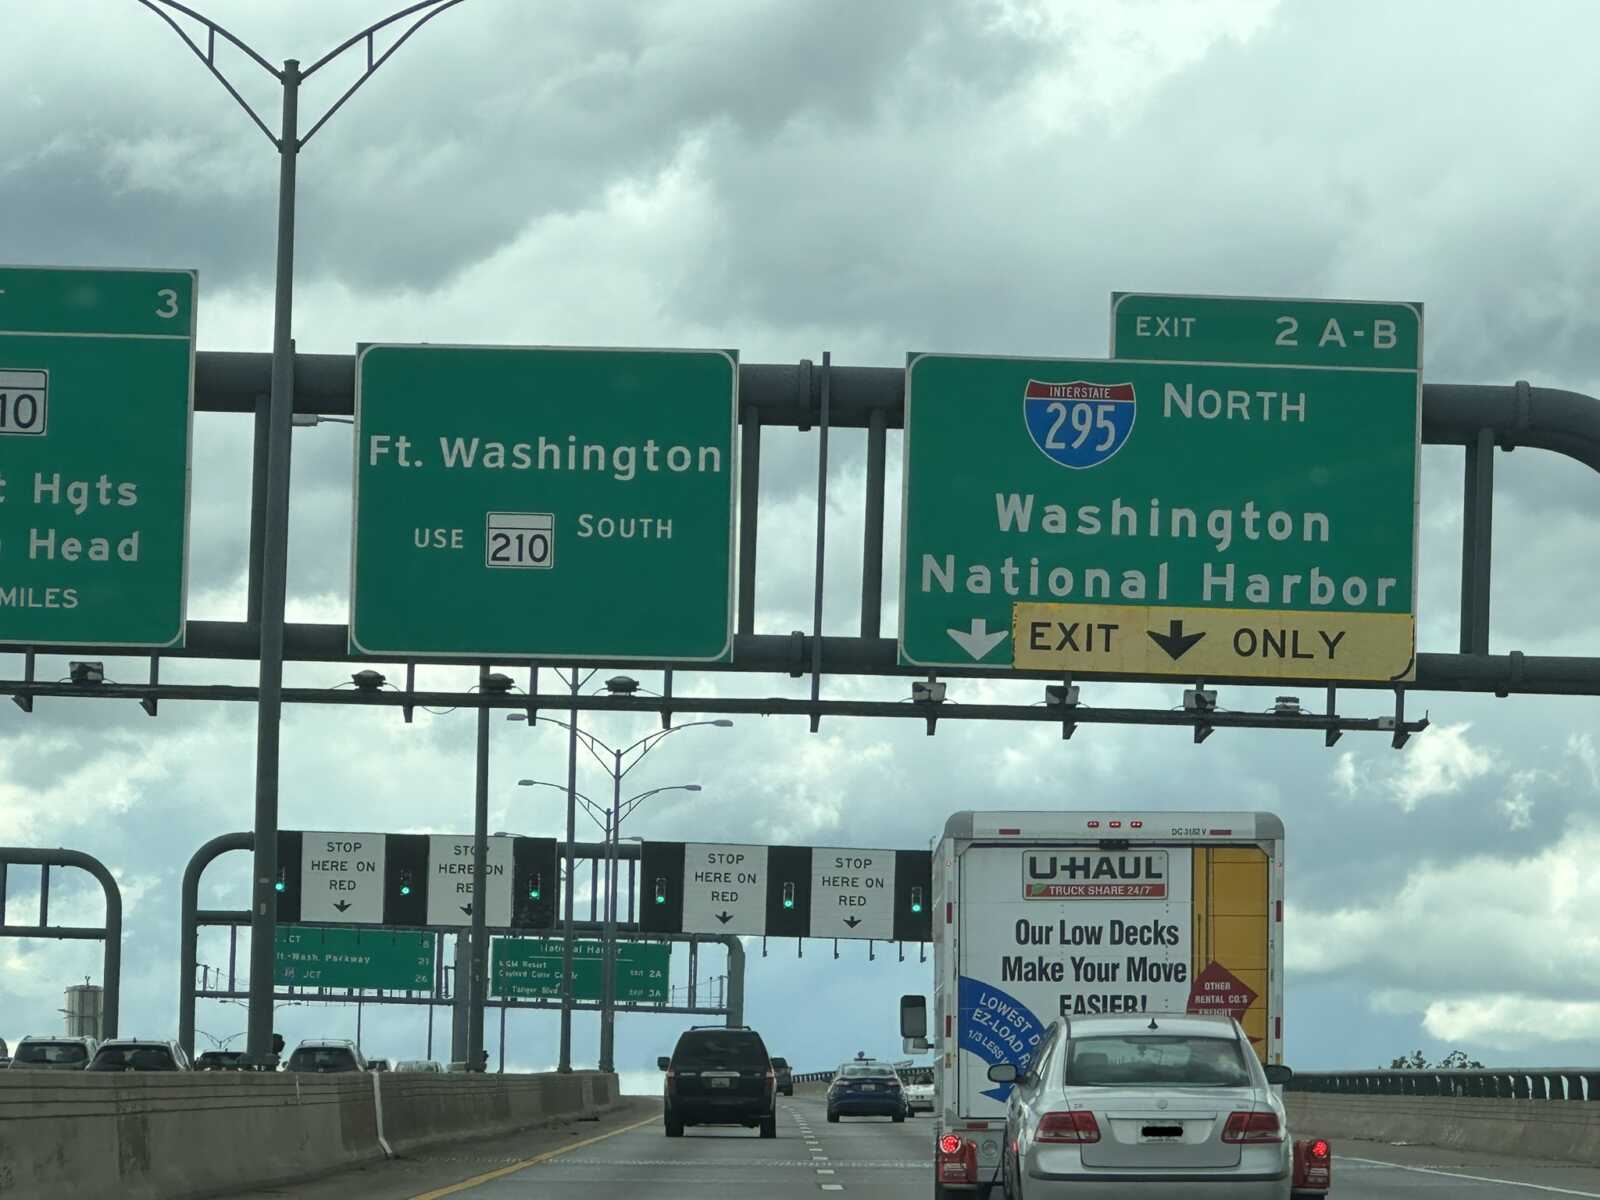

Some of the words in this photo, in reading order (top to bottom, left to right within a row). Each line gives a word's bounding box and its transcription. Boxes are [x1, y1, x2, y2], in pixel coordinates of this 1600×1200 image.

[155, 288, 179, 319] 3
[1135, 316, 1196, 339] EXIT
[1274, 316, 1299, 346] 2
[1319, 317, 1398, 350] A-B
[1048, 385, 1112, 401] INTERSTATE
[1163, 382, 1307, 423] NORTH
[1044, 401, 1117, 452] 295
[369, 434, 424, 468] Ft.
[439, 434, 722, 481] Washington
[33, 472, 139, 515] Hgts
[995, 492, 1331, 552] Washington
[29, 528, 140, 562] Head
[413, 528, 465, 550] USE
[490, 532, 549, 564] 210
[576, 513, 674, 540] SOUTH
[921, 553, 1168, 601] National
[1202, 562, 1397, 606] Harbor
[0, 586, 79, 609] MILES
[1029, 621, 1119, 653] EXIT
[1232, 628, 1347, 660] ONLY
[326, 841, 362, 854] STOP
[707, 853, 745, 865] STOP
[310, 860, 348, 873] HERE
[356, 861, 376, 873] ON
[834, 857, 873, 870] STOP
[1029, 855, 1164, 880] U-HAUL
[328, 880, 357, 892] RED
[694, 872, 732, 884] HERE
[737, 873, 757, 884] ON
[821, 876, 860, 888] HERE
[865, 877, 885, 889] ON
[1049, 885, 1086, 896] TRUCK
[1087, 885, 1125, 896] SHARE
[1126, 885, 1152, 897] 24/7
[711, 891, 738, 903] RED
[838, 895, 867, 907] RED
[1015, 918, 1054, 946] Our
[1059, 918, 1104, 946] Low
[1109, 918, 1180, 946] Decks
[648, 969, 662, 979] 2A
[1001, 956, 1064, 983] Make
[1069, 956, 1120, 983] Your
[1126, 956, 1187, 983] Move
[1203, 981, 1231, 991] OTHER
[979, 991, 1033, 1034] LOWEST
[1194, 994, 1225, 1005] RENTAL
[971, 1007, 1025, 1054] EZ-LOAD
[967, 1029, 984, 1043] 1/3
[981, 1037, 1005, 1060] LESS
